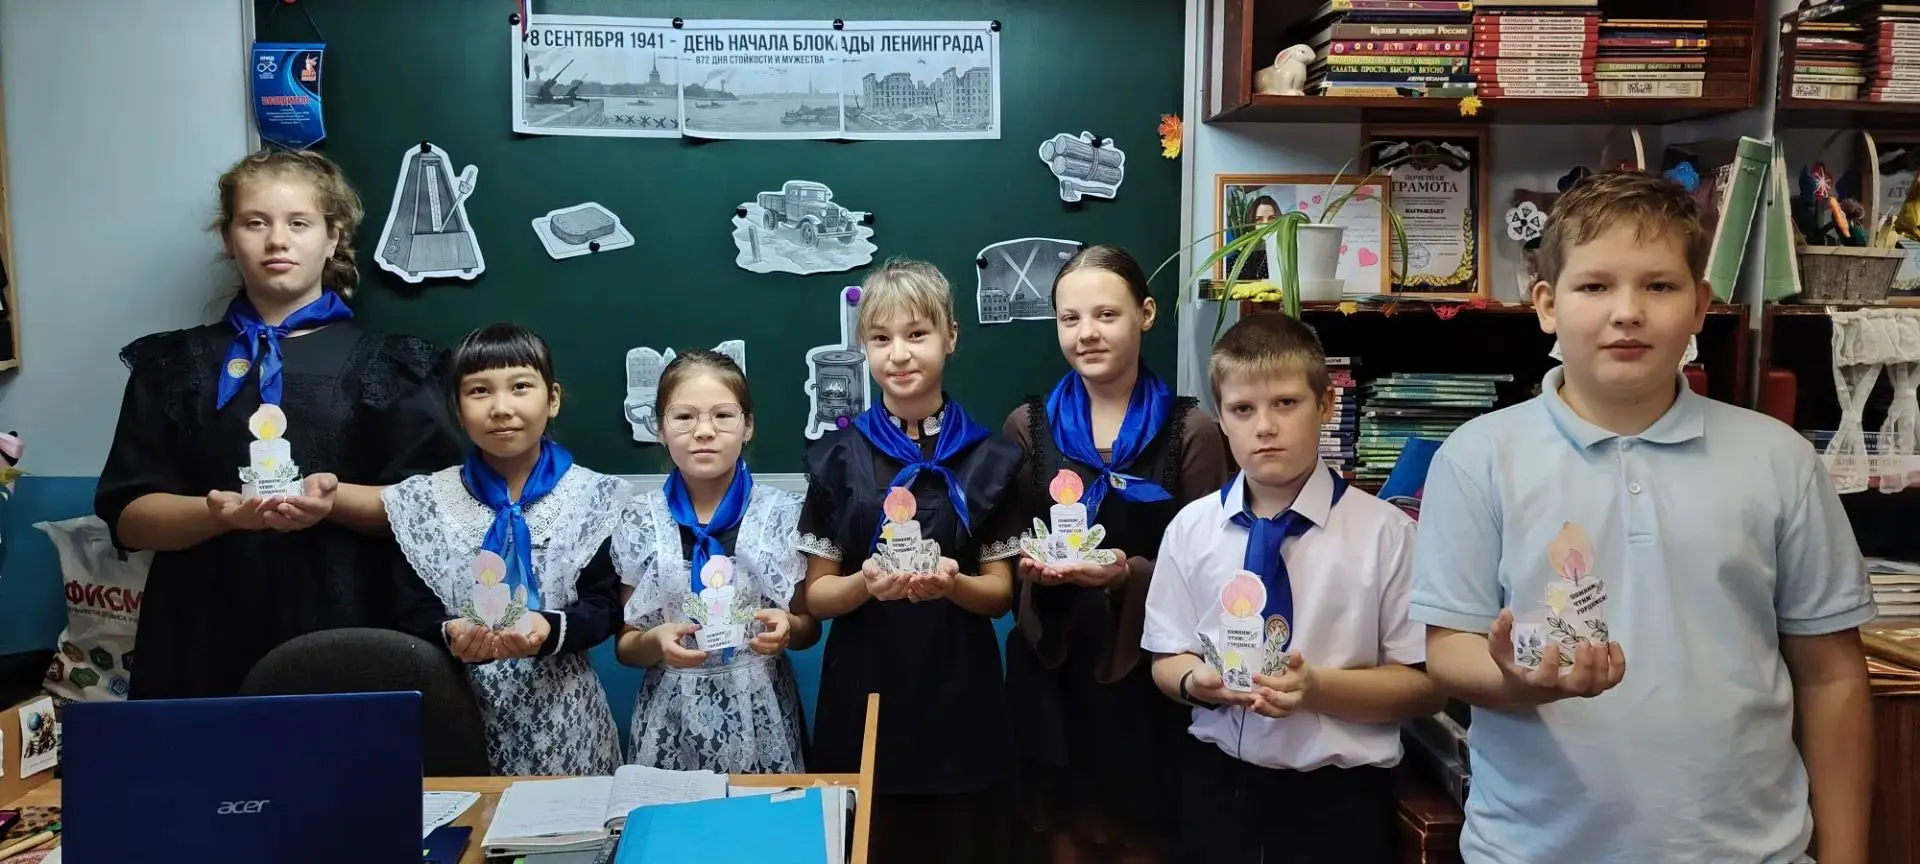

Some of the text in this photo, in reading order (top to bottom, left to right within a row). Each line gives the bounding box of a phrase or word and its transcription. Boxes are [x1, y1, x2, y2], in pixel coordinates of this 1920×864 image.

[530, 30, 540, 46] 8
[544, 30, 624, 48] СЕНТЯБРЯ
[630, 32, 664, 49] 1941
[683, 34, 724, 54] ДЕНЬ
[728, 34, 789, 52] НАЧАЛА
[880, 35, 984, 54] ЛЕНИНГРАДА
[695, 54, 825, 65] 872 ДНЯ СТОЙКОСТИ И МУЖЕСТВА
[1391, 181, 1459, 193] ГРАМОТА
[217, 800, 270, 814] acer
